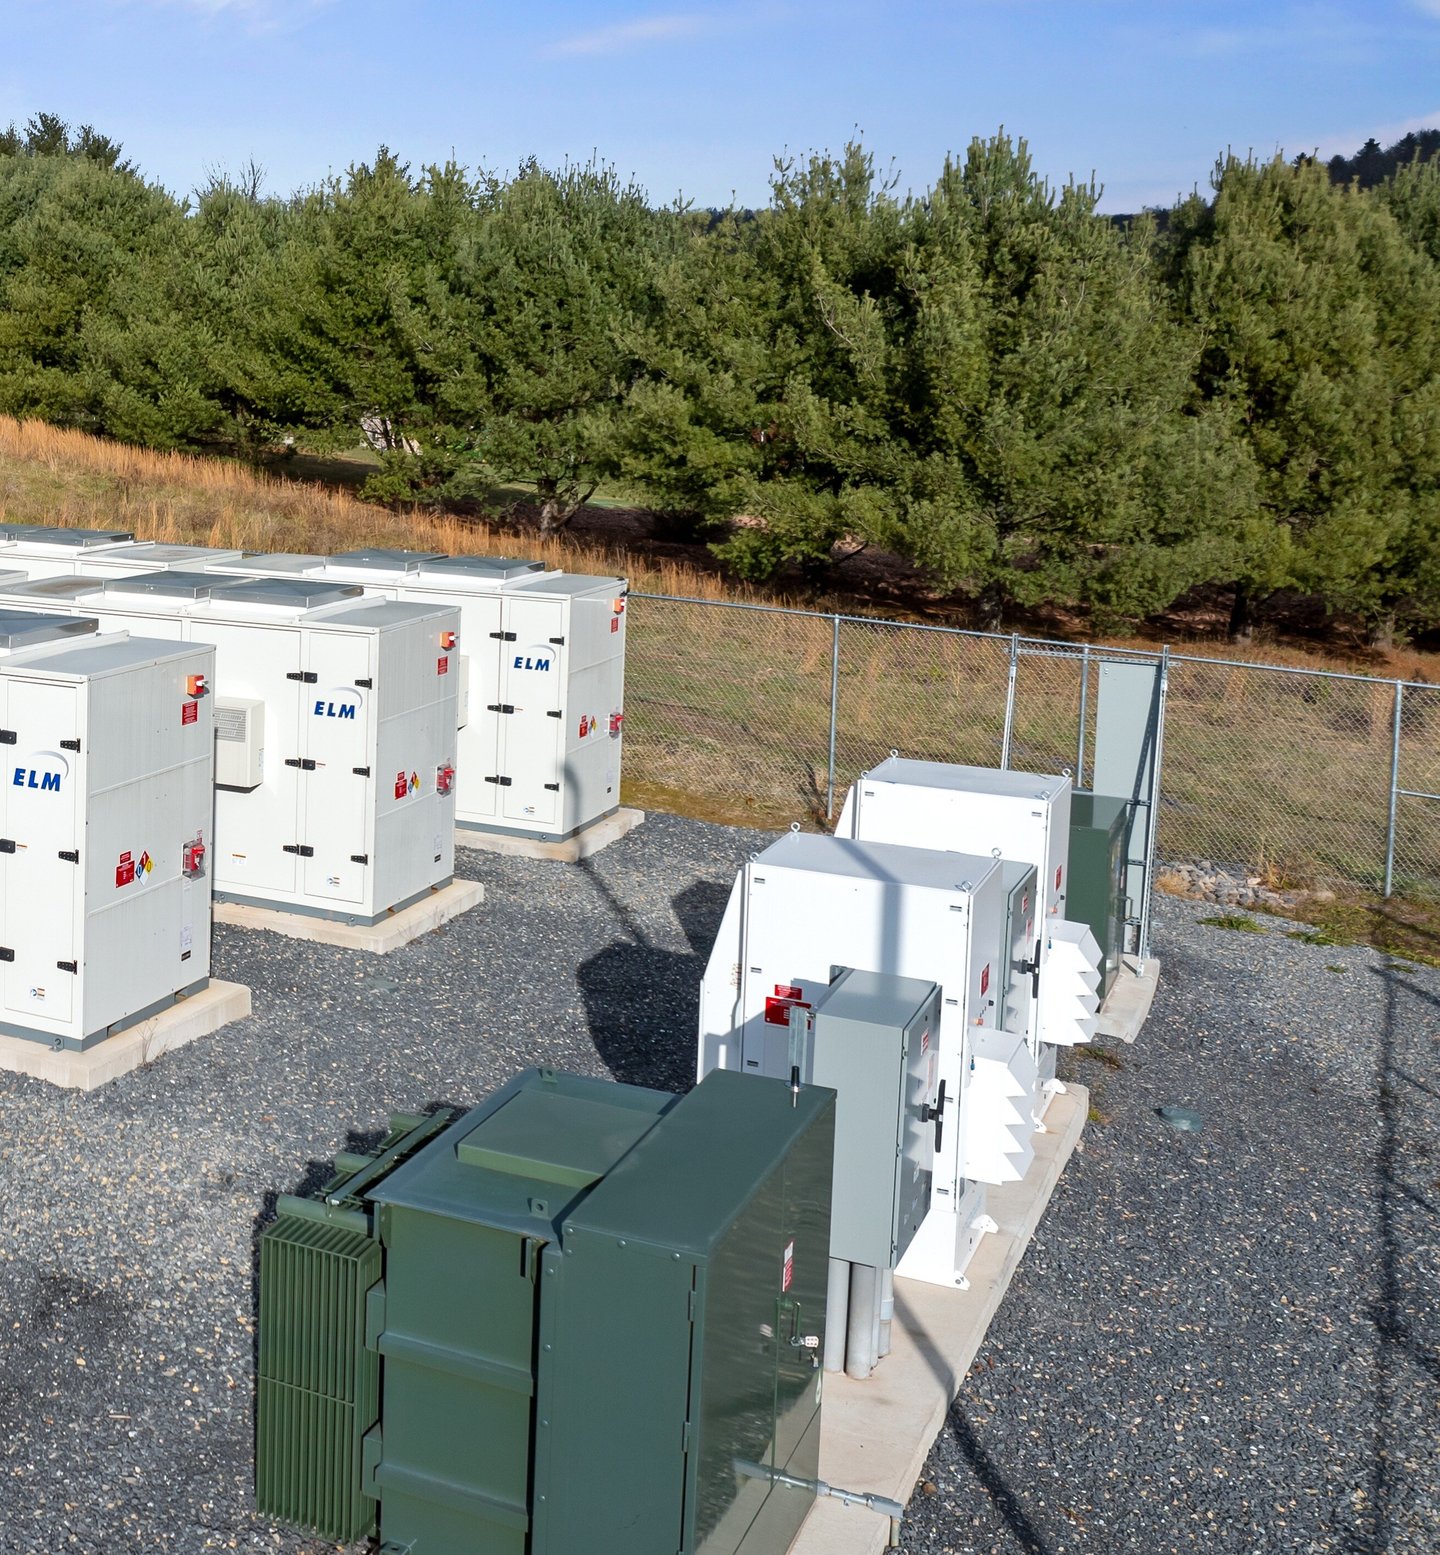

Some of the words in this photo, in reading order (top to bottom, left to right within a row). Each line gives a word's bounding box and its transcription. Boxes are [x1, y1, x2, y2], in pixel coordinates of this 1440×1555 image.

[514, 656, 550, 671] ELM
[314, 701, 356, 720] ELM
[13, 768, 62, 792] ELM
